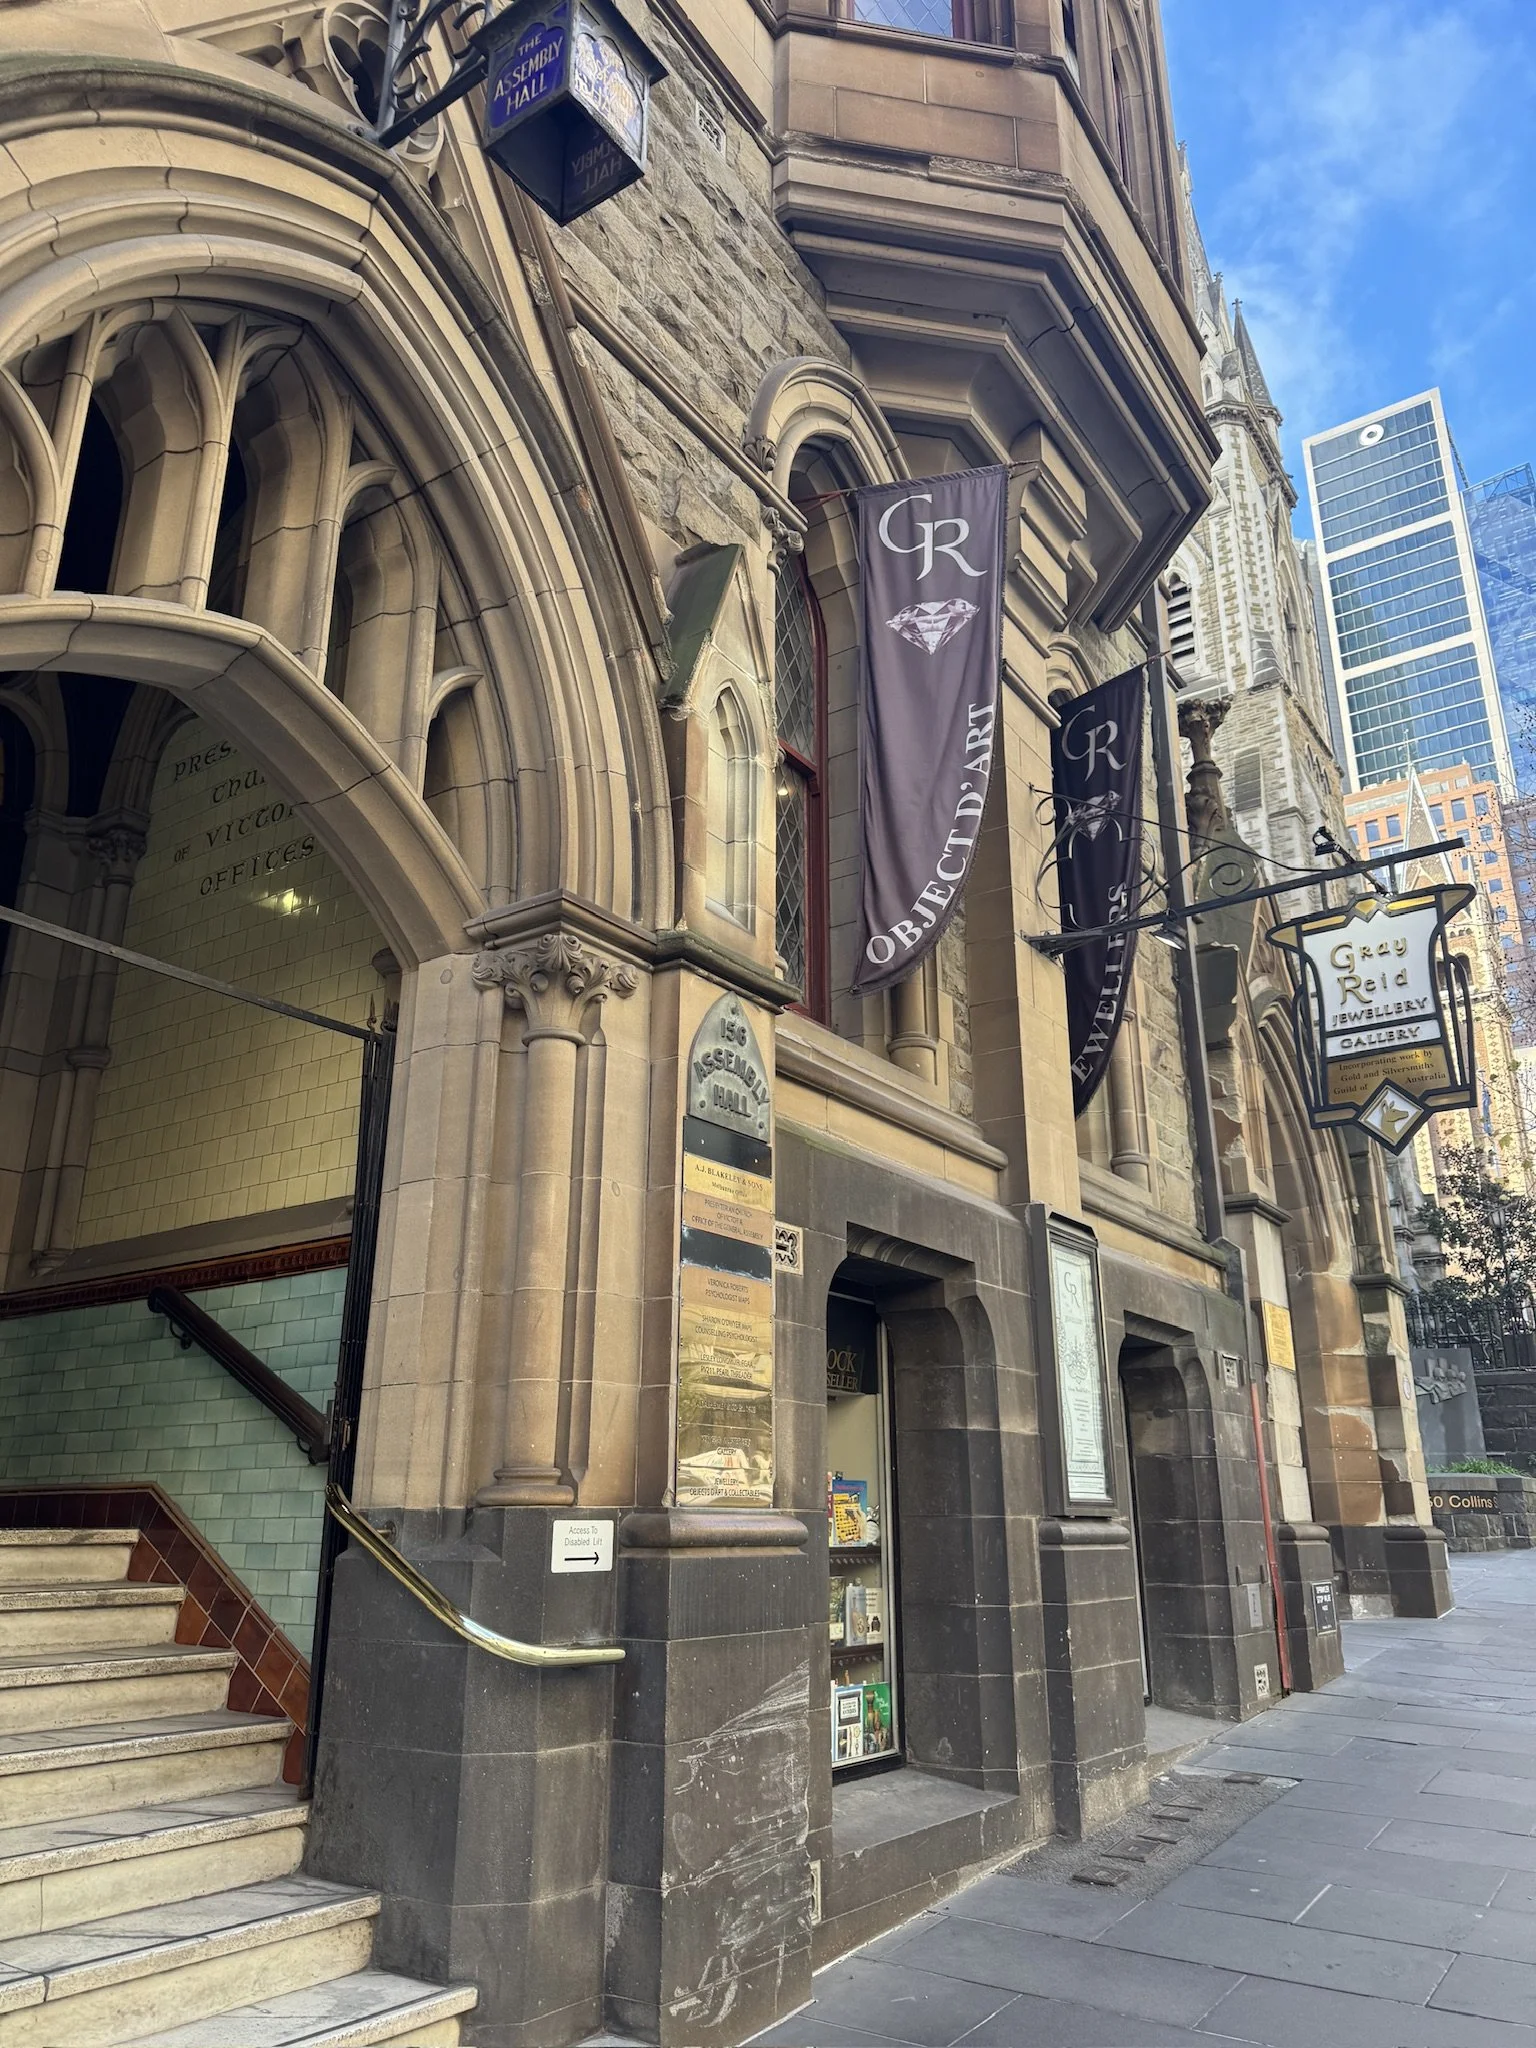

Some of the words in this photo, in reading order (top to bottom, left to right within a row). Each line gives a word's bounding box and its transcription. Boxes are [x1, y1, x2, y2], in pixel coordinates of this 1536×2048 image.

[518, 32, 542, 56] THE
[494, 36, 564, 102] ASSEMBLY
[506, 73, 548, 116] HALL
[174, 740, 238, 782] PRES
[212, 769, 265, 804] CHU
[174, 845, 191, 864] OF
[200, 836, 315, 896] OFFICES
[866, 828, 974, 964] OBJECT
[1330, 936, 1408, 974] Gray
[1337, 968, 1409, 1005] Reid
[1332, 996, 1429, 1027] JEWELLERY
[720, 1017, 747, 1048] 156
[1339, 1026, 1421, 1049] GALLERY
[1339, 1056, 1397, 1071] Incorporating
[1399, 1051, 1420, 1060] work
[1423, 1049, 1433, 1059] by
[1340, 1073, 1360, 1082] Gold
[1363, 1070, 1379, 1079] and
[1382, 1062, 1434, 1076] Silversmiths
[693, 1048, 770, 1106] ASSEMBLY
[1333, 1085, 1357, 1095] Guild
[1405, 1072, 1446, 1084] Australia
[713, 1084, 751, 1117] HALL
[707, 1167, 741, 1184] BLAKELEY
[747, 1179, 763, 1191] SONS
[1449, 1495, 1493, 1509] Collins
[564, 1537, 590, 1546] Disabled
[593, 1537, 602, 1546] Lift
[569, 1526, 590, 1535] Access
[591, 1526, 598, 1534] To
